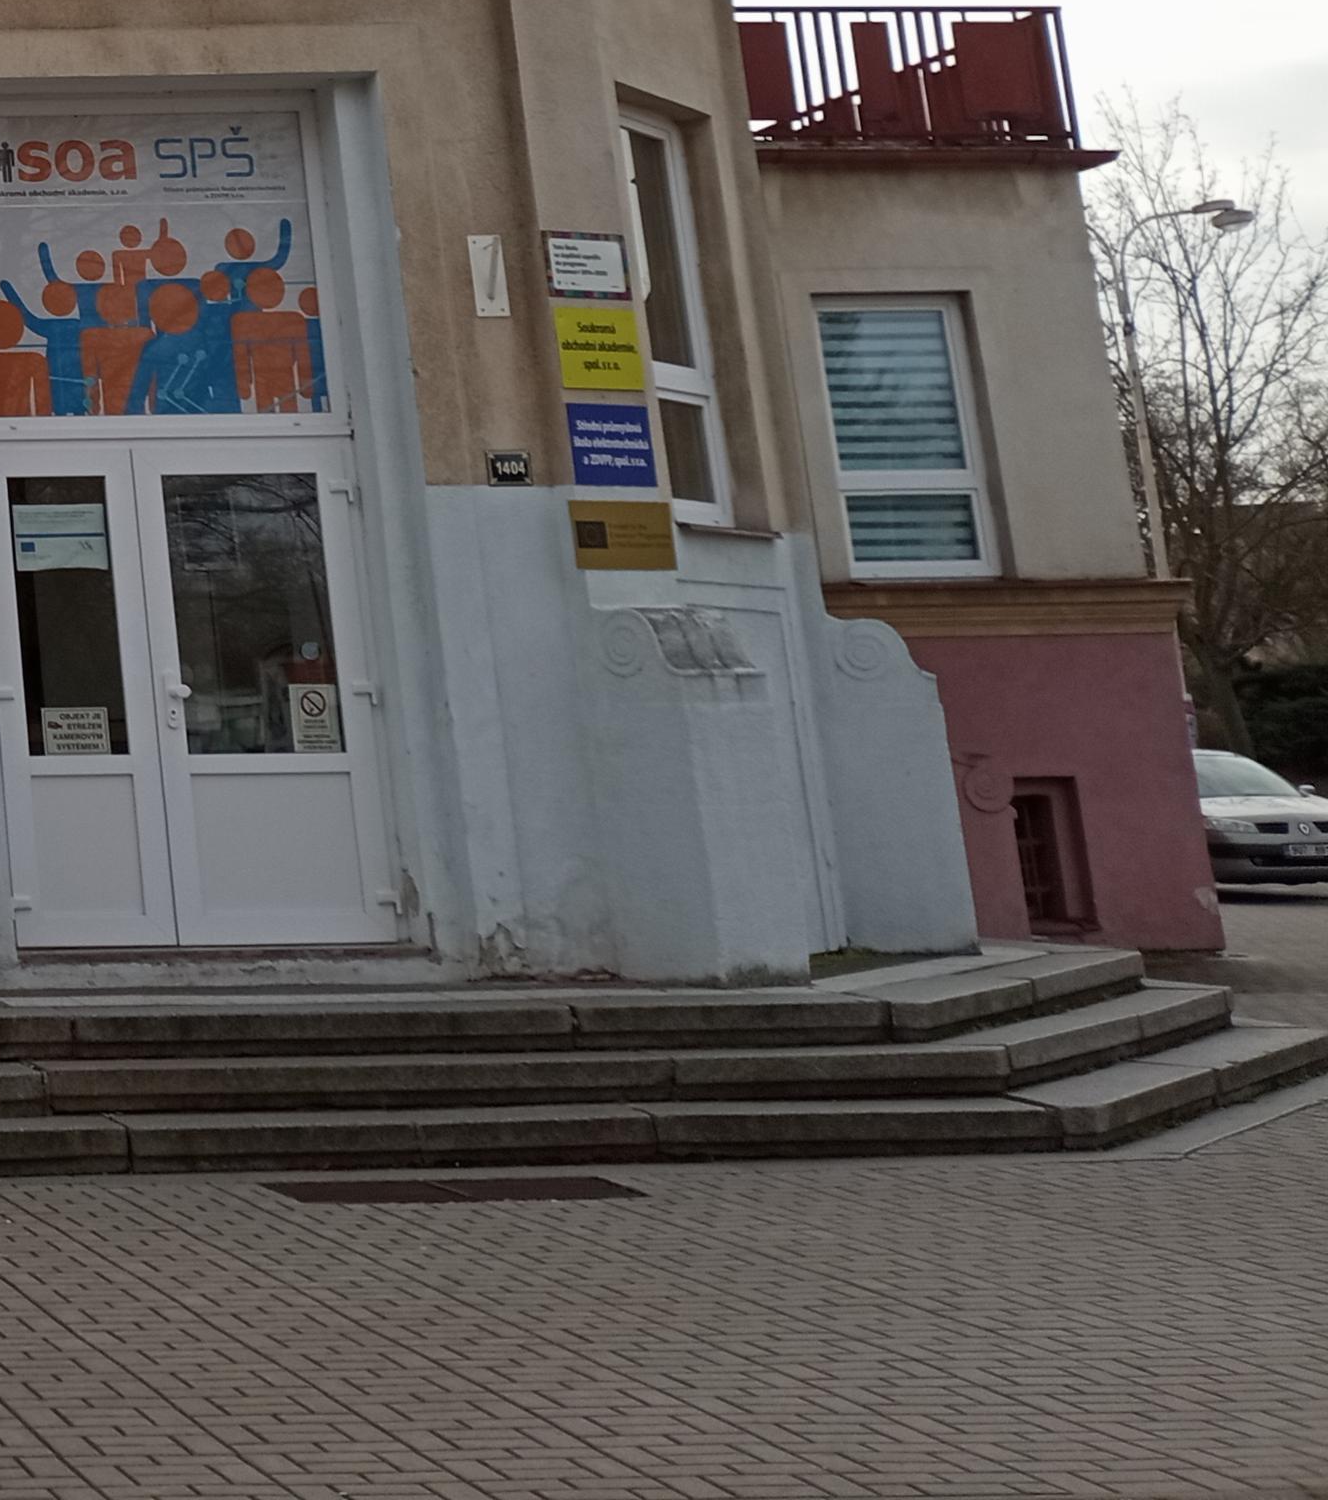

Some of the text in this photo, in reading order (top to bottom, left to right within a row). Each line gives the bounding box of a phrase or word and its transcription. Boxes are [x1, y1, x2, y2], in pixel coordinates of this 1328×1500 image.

[17, 139, 137, 182] soa
[154, 126, 254, 178] SPŠ
[496, 461, 525, 476] 1404
